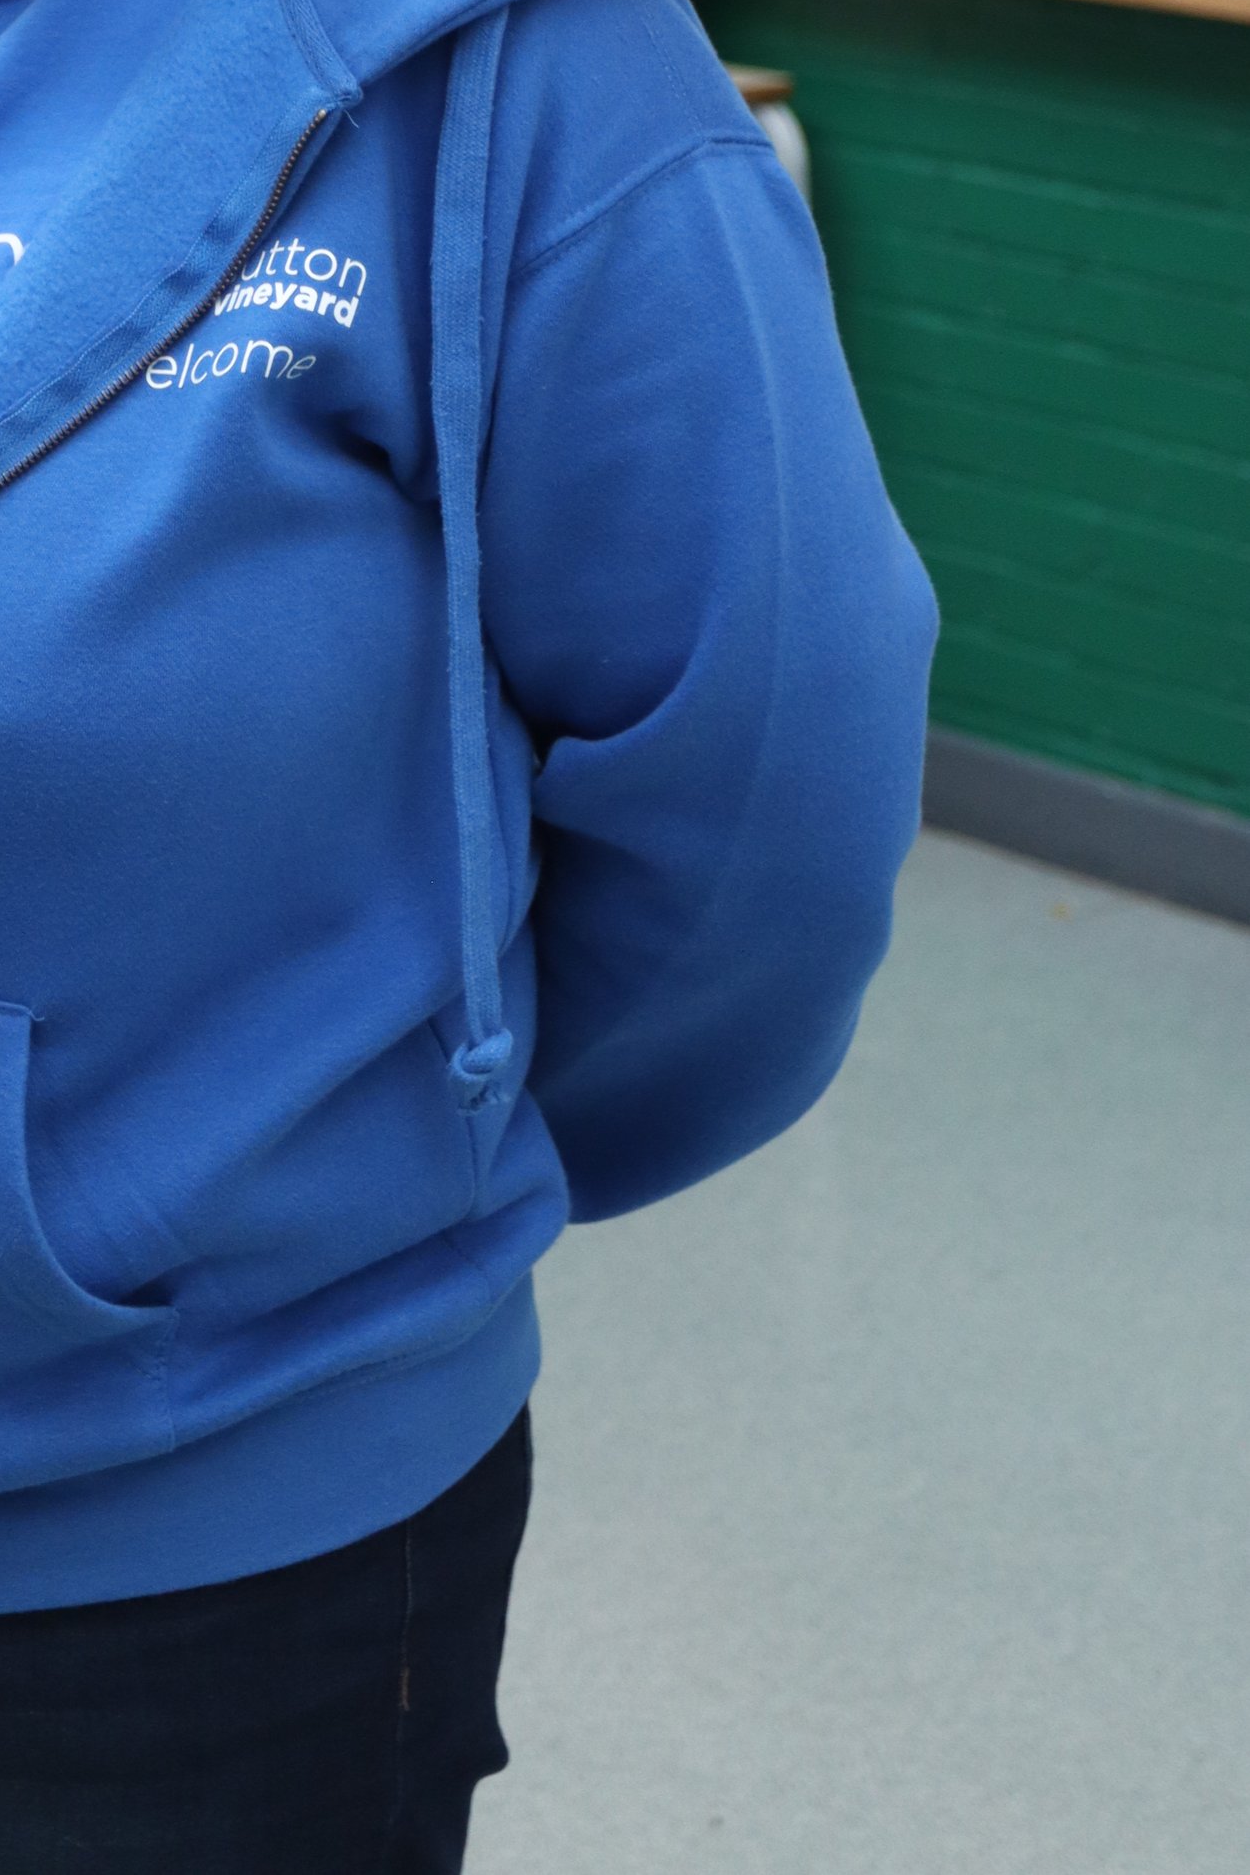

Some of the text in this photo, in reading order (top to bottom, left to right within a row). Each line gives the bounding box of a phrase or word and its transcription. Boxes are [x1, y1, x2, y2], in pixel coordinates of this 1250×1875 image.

[241, 237, 367, 297] utton
[213, 281, 360, 328] vineyard
[145, 339, 317, 390] elcome
